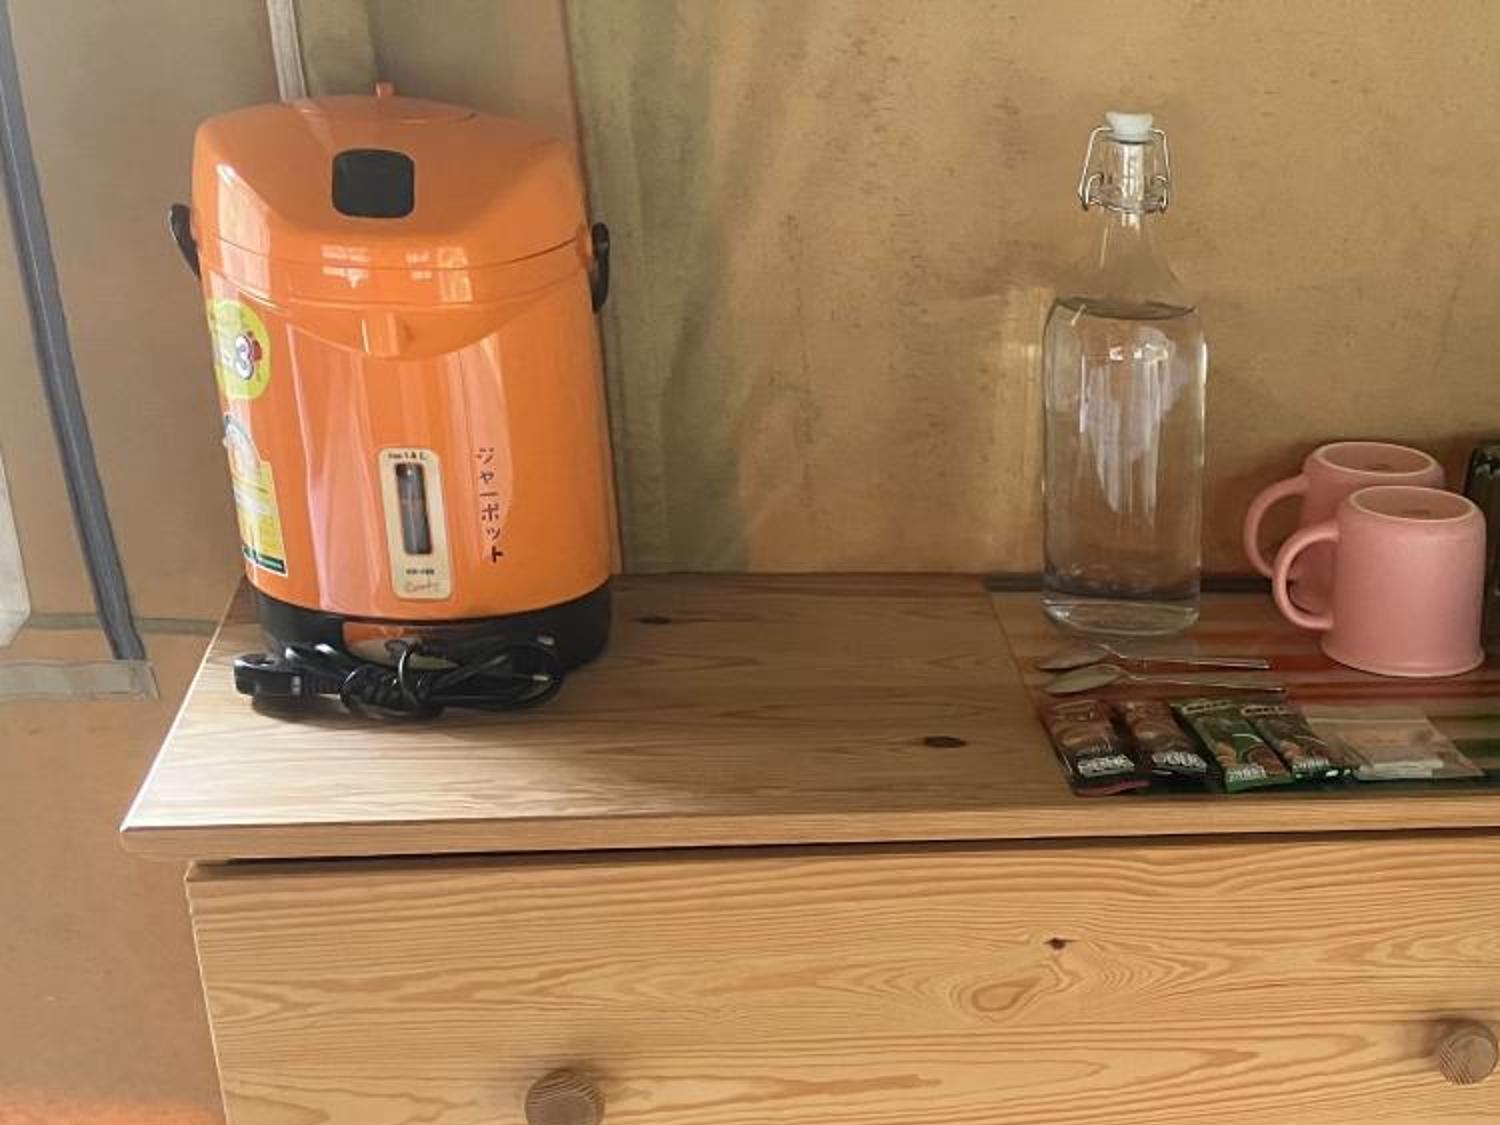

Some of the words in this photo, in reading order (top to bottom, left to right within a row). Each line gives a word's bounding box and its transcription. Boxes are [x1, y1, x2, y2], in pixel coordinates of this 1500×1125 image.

[476, 448, 505, 562] ジャーポット
